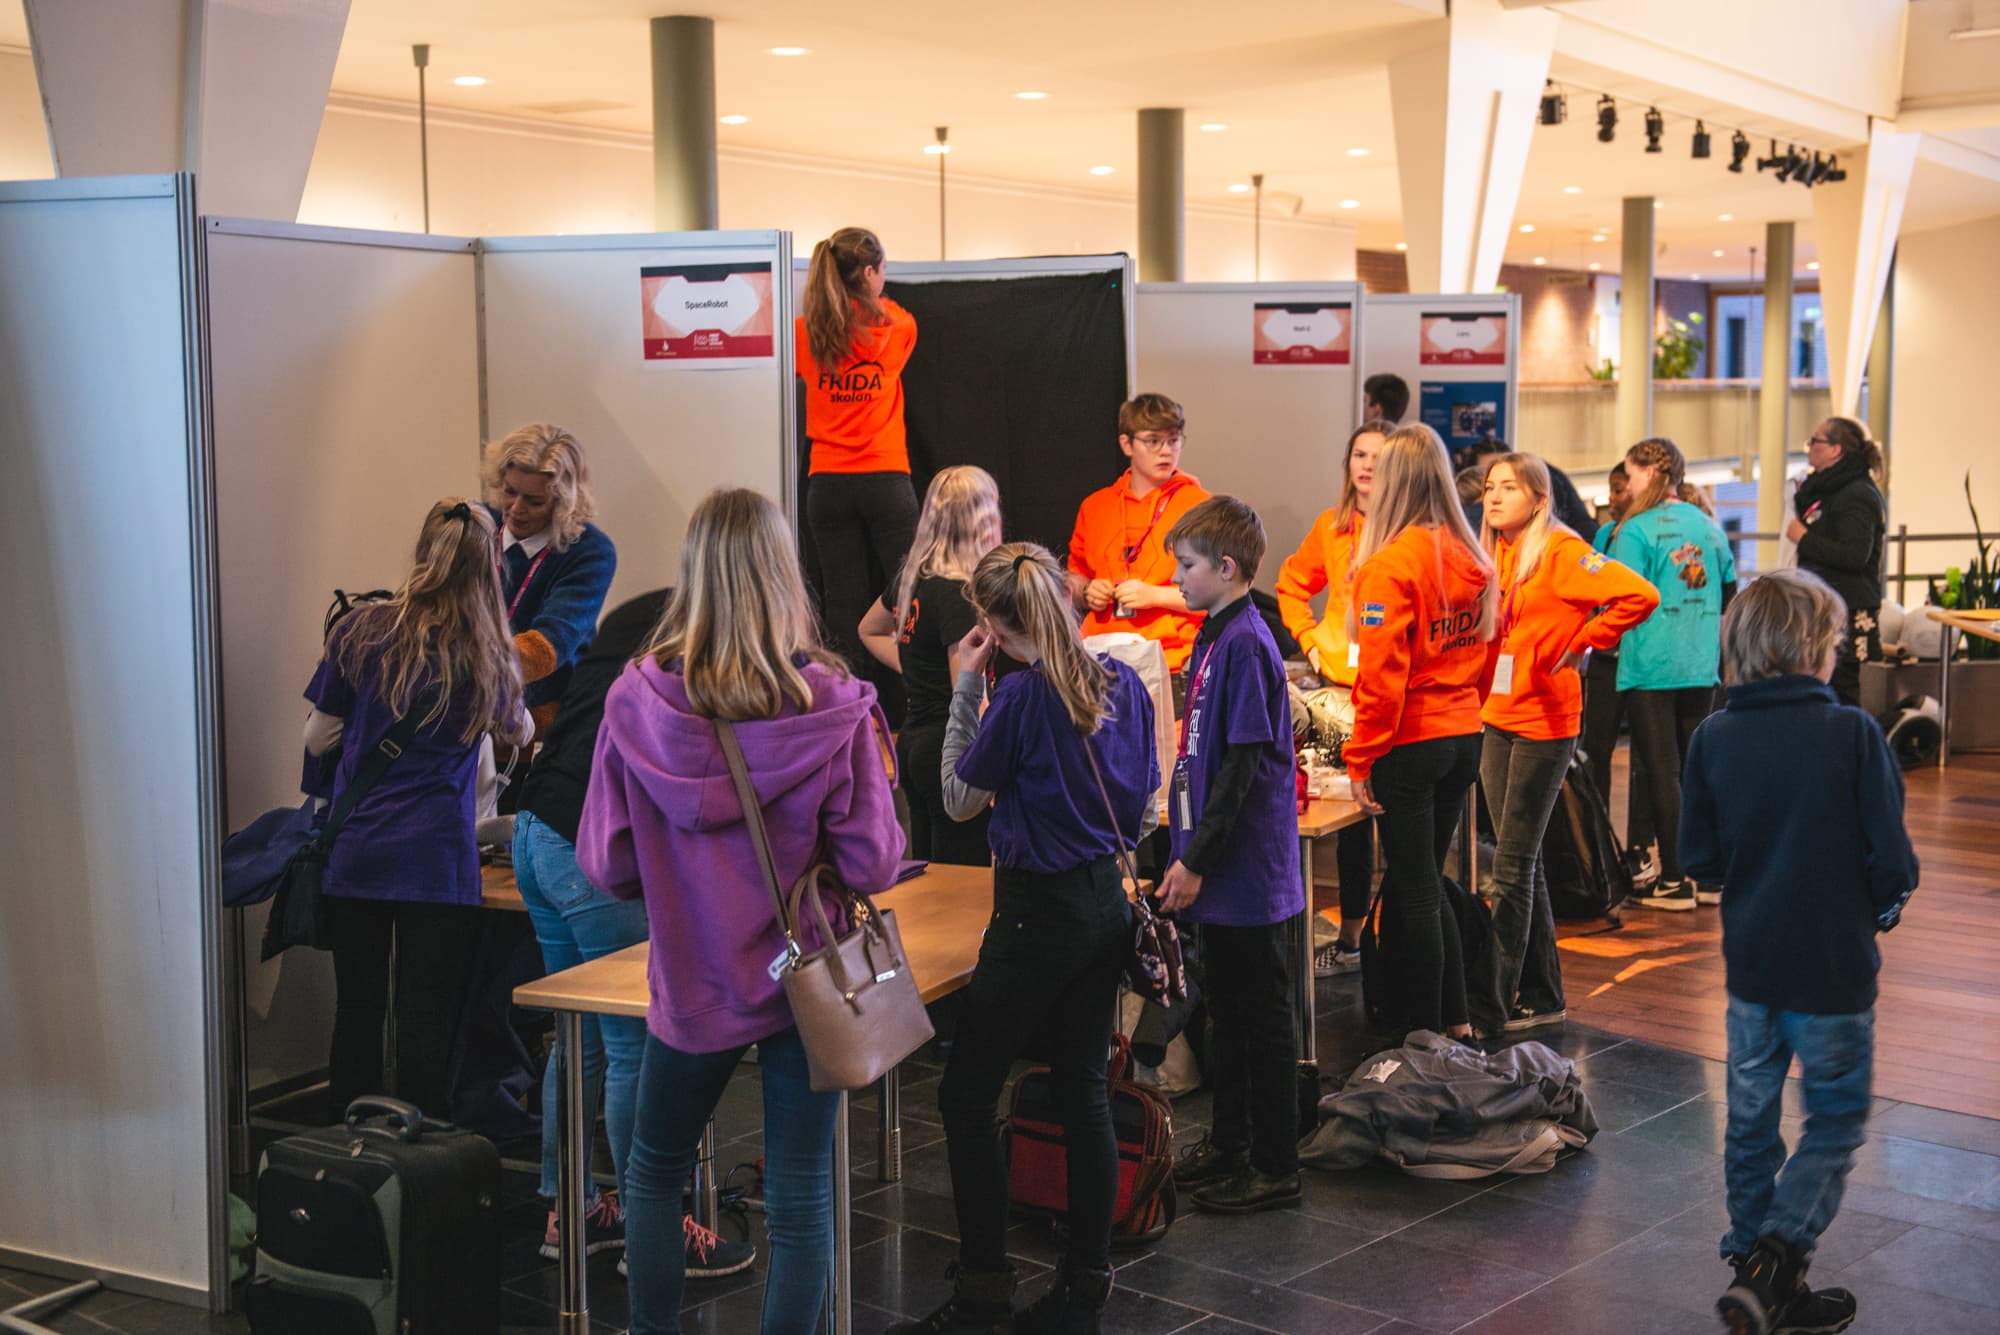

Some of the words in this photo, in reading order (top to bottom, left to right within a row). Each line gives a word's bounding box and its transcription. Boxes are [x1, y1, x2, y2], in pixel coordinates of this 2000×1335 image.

[685, 300, 728, 310] SpaceRobot
[818, 372, 882, 391] FRIDA
[831, 392, 872, 403] skolan
